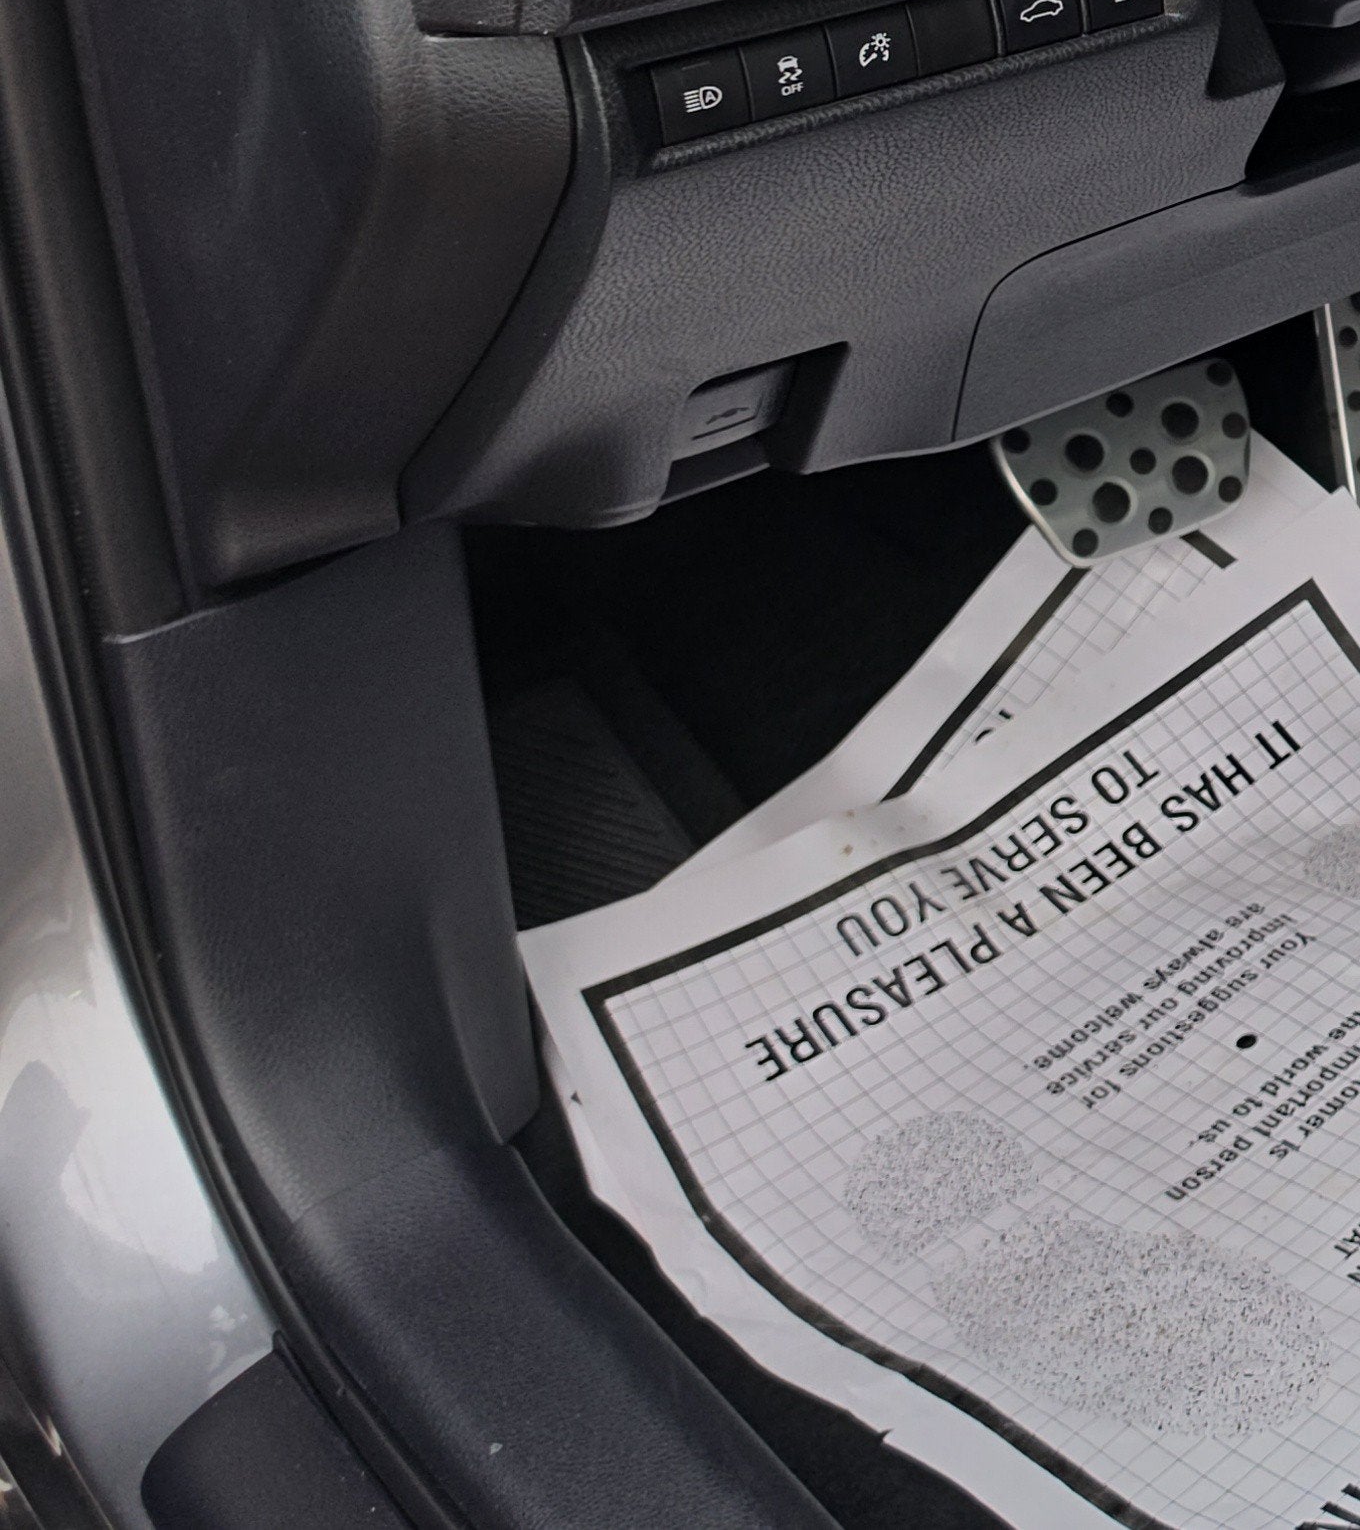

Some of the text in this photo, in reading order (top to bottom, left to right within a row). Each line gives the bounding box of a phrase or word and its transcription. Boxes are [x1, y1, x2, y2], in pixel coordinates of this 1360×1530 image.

[781, 82, 804, 96] OFF
[836, 750, 1160, 957] TO SERVE YOU
[745, 719, 1301, 1082] IT HAS BEEN A PLEASURE
[1023, 902, 1265, 1071] are always welcome.
[1046, 912, 1296, 1095] improving our service
[1081, 931, 1316, 1109] Your suggestions for
[1260, 1043, 1329, 1098] world
[1188, 1118, 1231, 1149] us.
[1232, 1096, 1264, 1118] to
[1165, 1134, 1254, 1202] person
[1269, 1138, 1303, 1161] is
